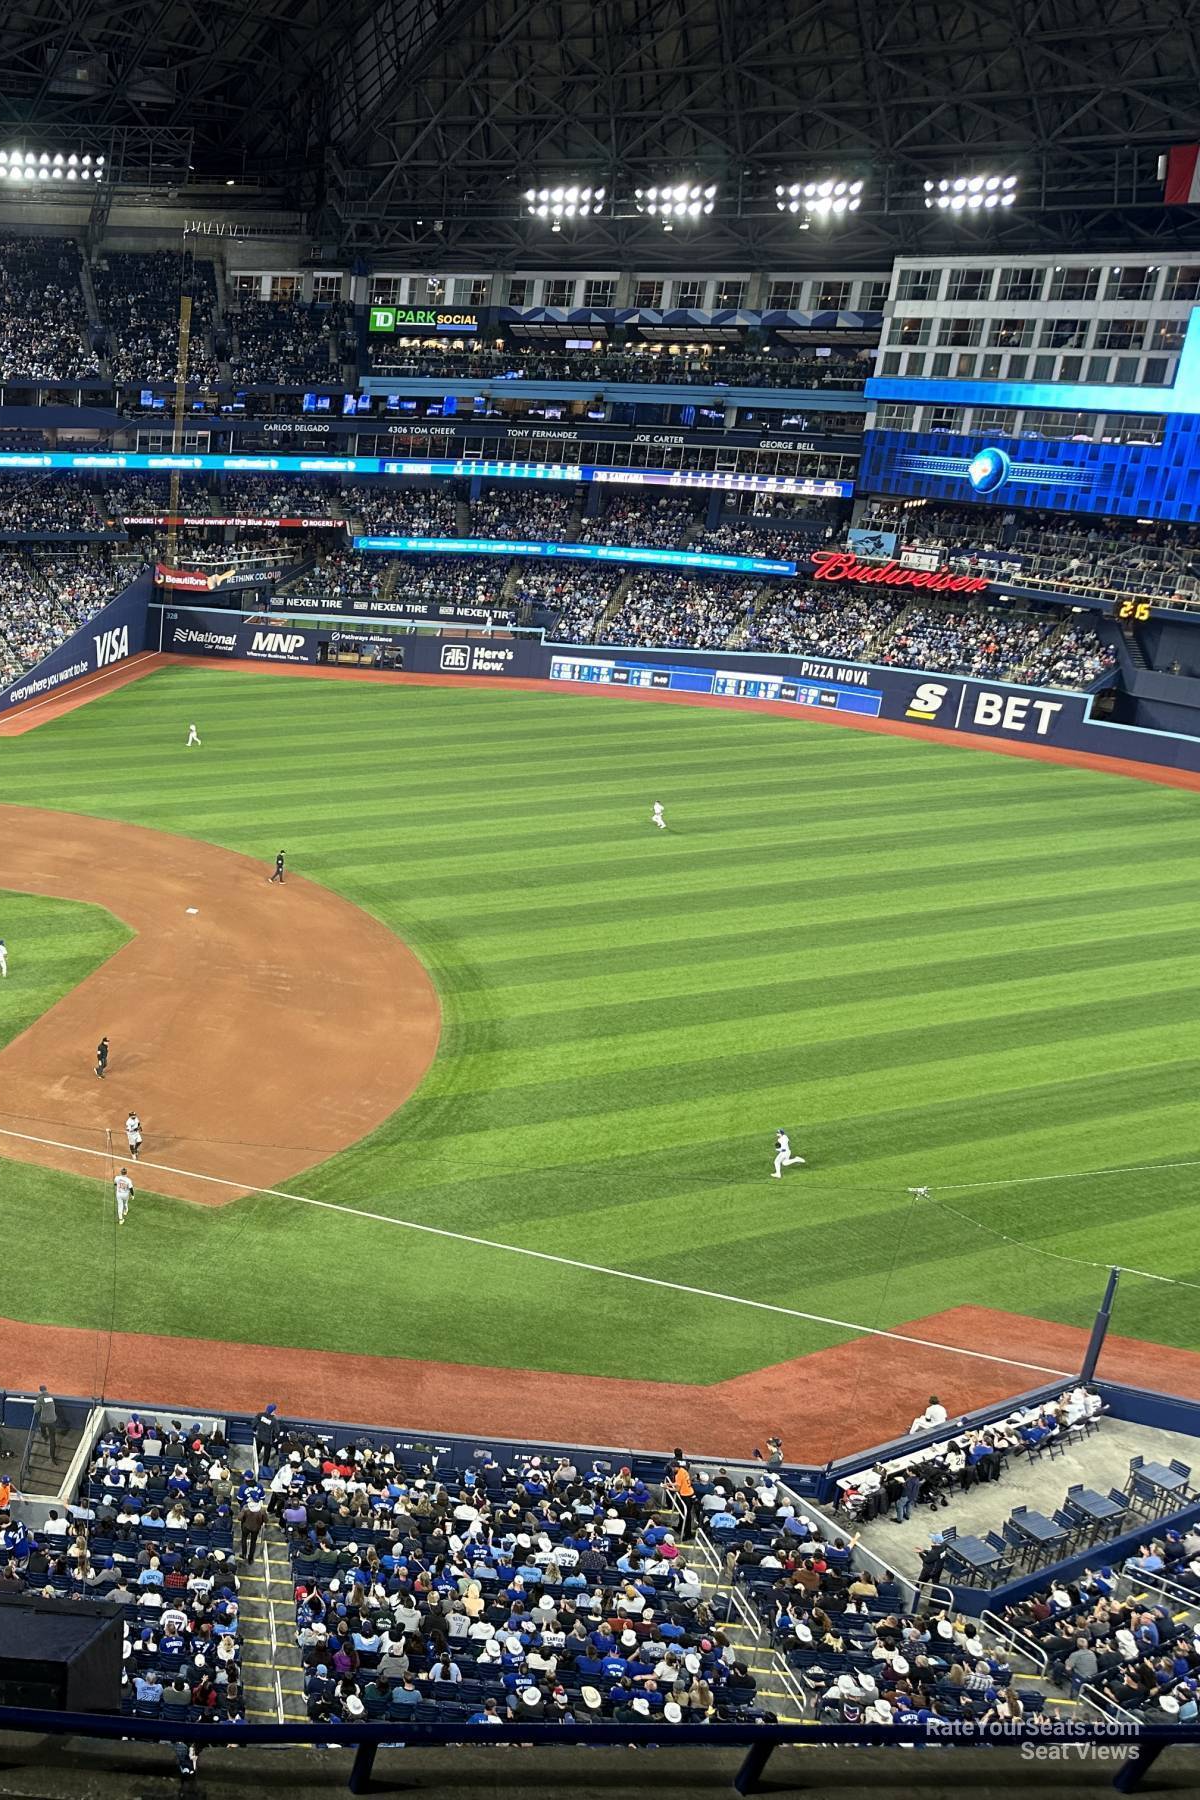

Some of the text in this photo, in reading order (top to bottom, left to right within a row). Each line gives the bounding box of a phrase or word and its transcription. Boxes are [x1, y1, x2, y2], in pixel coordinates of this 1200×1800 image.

[372, 310, 478, 327] TD PARK SOCIAL
[294, 424, 330, 432] DELGADO
[388, 426, 456, 435] 4306 TOM CHEEK
[506, 429, 578, 439] TONY FERNANDEZ
[634, 434, 684, 444] JOE CARTER
[759, 440, 815, 451] GEORGE BELL
[131, 517, 154, 525] ROGERS
[226, 570, 282, 584] RETHINK COLOUR
[810, 551, 991, 593] Budweiser
[165, 574, 207, 586] BeautiTone
[286, 598, 319, 607] NEXEN
[320, 599, 343, 609] TIRE
[370, 602, 404, 612] NEXEN
[405, 604, 429, 613] TIRE
[456, 607, 490, 617] NEXEN
[251, 632, 305, 654] MNP
[341, 633, 393, 643] Pathways Alliance
[93, 624, 129, 668] VISA
[473, 647, 514, 660] Here's
[472, 659, 504, 671] How.
[801, 661, 868, 685] PIZZA NOVA
[10, 660, 89, 702] everywhere you want to be
[973, 692, 1063, 735] BET
[455, 1623, 463, 1634] 7
